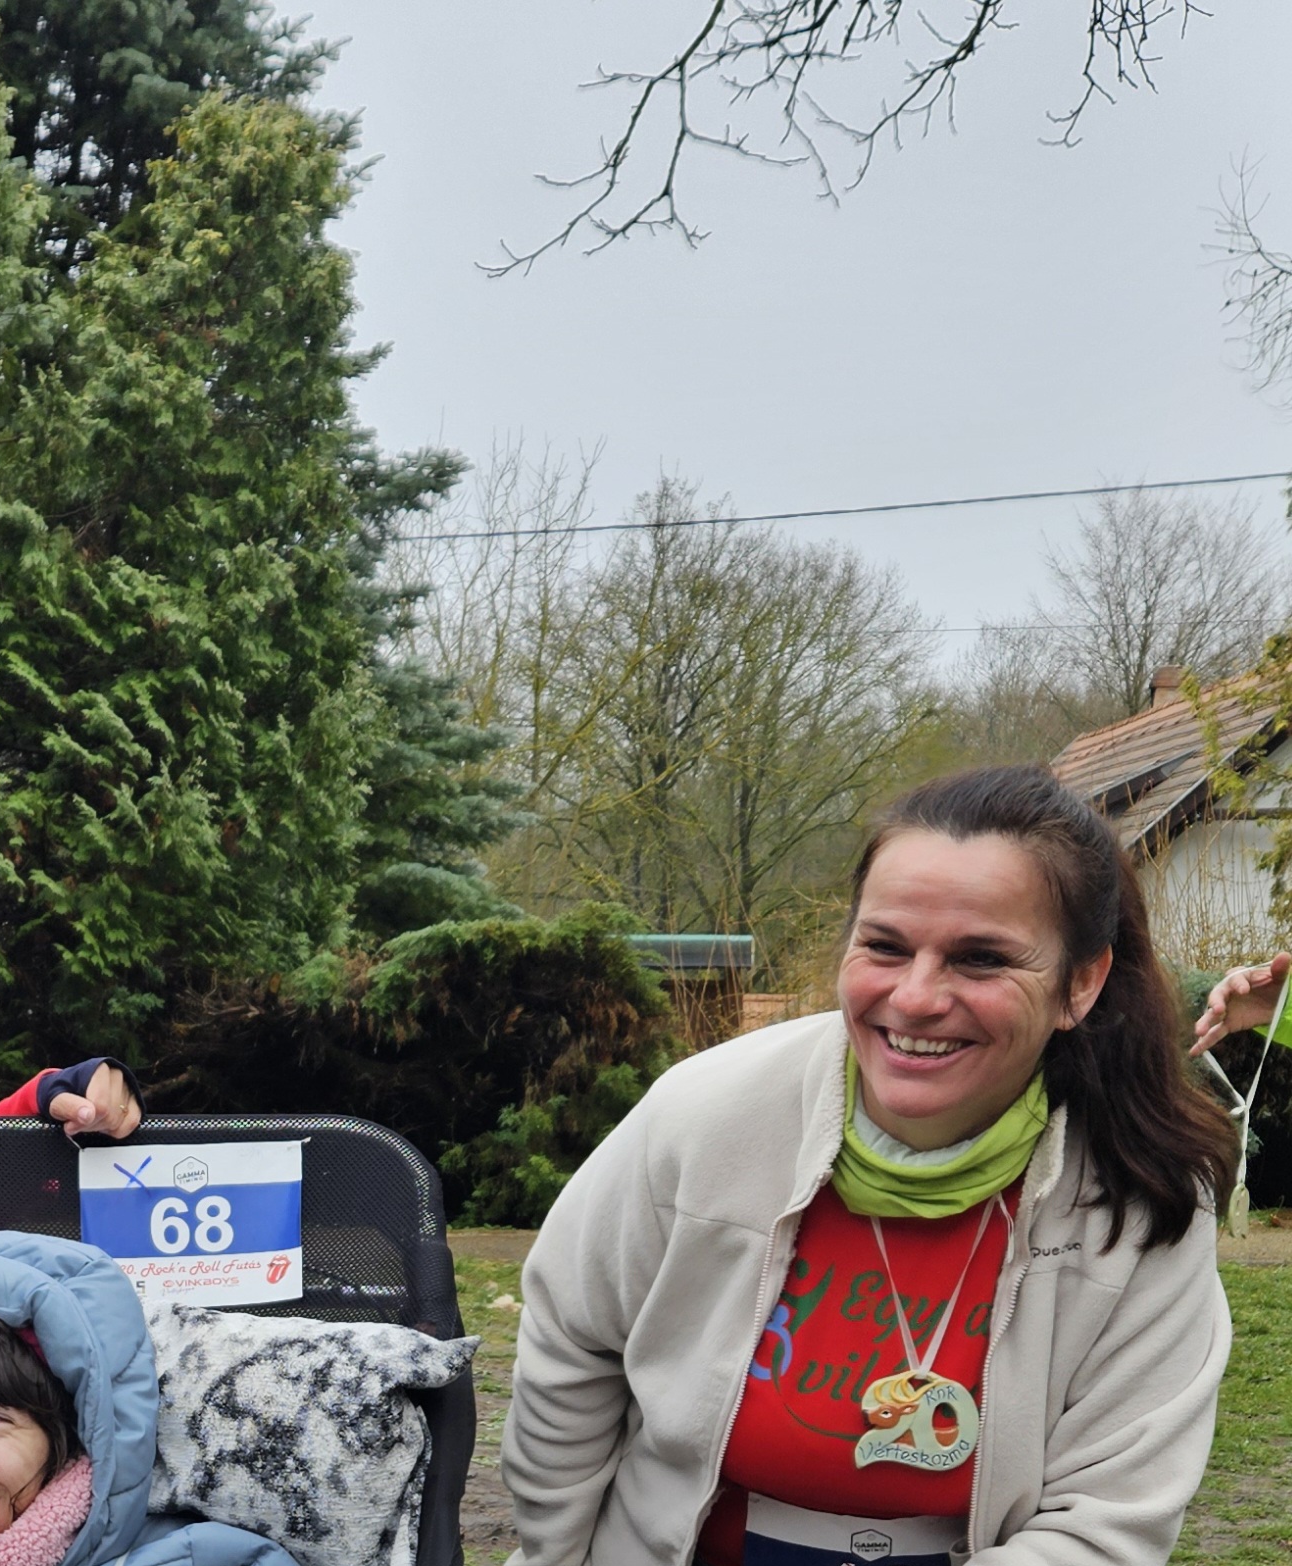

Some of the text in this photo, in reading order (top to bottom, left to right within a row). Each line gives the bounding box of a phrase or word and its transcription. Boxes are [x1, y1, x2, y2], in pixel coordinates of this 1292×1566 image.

[176, 1169, 206, 1180] GAMMA
[150, 1195, 234, 1254] 68
[140, 1261, 187, 1278] Rock'n
[189, 1260, 220, 1276] Roll
[222, 1259, 262, 1274] Futás
[175, 1276, 240, 1288] VINKBOYS
[840, 1270, 951, 1346] Egy
[859, 1439, 970, 1467] Vérteskozma
[853, 1541, 889, 1549] GAMMA
